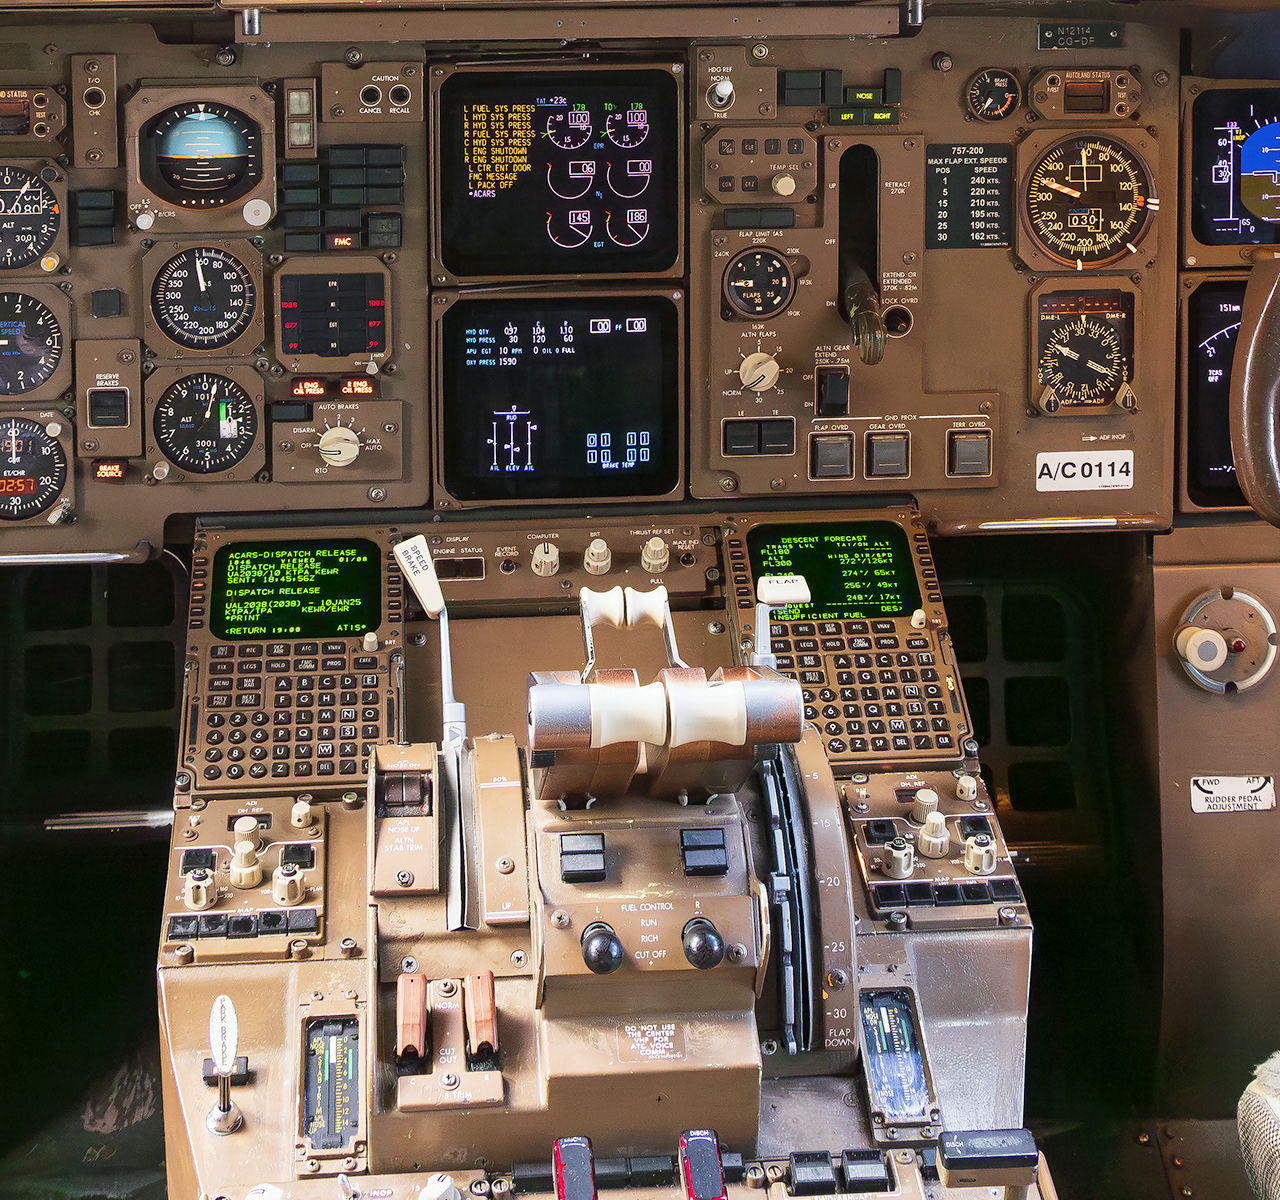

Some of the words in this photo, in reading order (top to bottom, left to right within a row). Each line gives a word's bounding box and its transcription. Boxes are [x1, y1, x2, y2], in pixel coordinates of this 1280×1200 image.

[1058, 27, 1090, 35] N12114
[937, 233, 947, 241] 30
[970, 232, 985, 240] 162
[334, 238, 352, 246] FMC
[1037, 463, 1077, 480] A/C
[1081, 462, 1131, 478] 0114
[229, 551, 311, 559] ACARS-DISPATCH
[316, 549, 357, 557] RELEASE
[226, 589, 276, 597] DISPATCH
[279, 587, 320, 595] RELEASE
[225, 601, 301, 609] UAL2038(2038)
[302, 605, 349, 613] KEWR/EWR
[773, 612, 838, 620] INSUFFICIENT
[621, 903, 638, 911] FUEL
[640, 902, 674, 911] CONTROL
[640, 919, 657, 927] RUN
[640, 934, 658, 943] RICH
[634, 950, 650, 959] CUT
[652, 950, 666, 958] OFF
[829, 1029, 851, 1037] FLAP
[825, 1038, 855, 1046] DOWN
